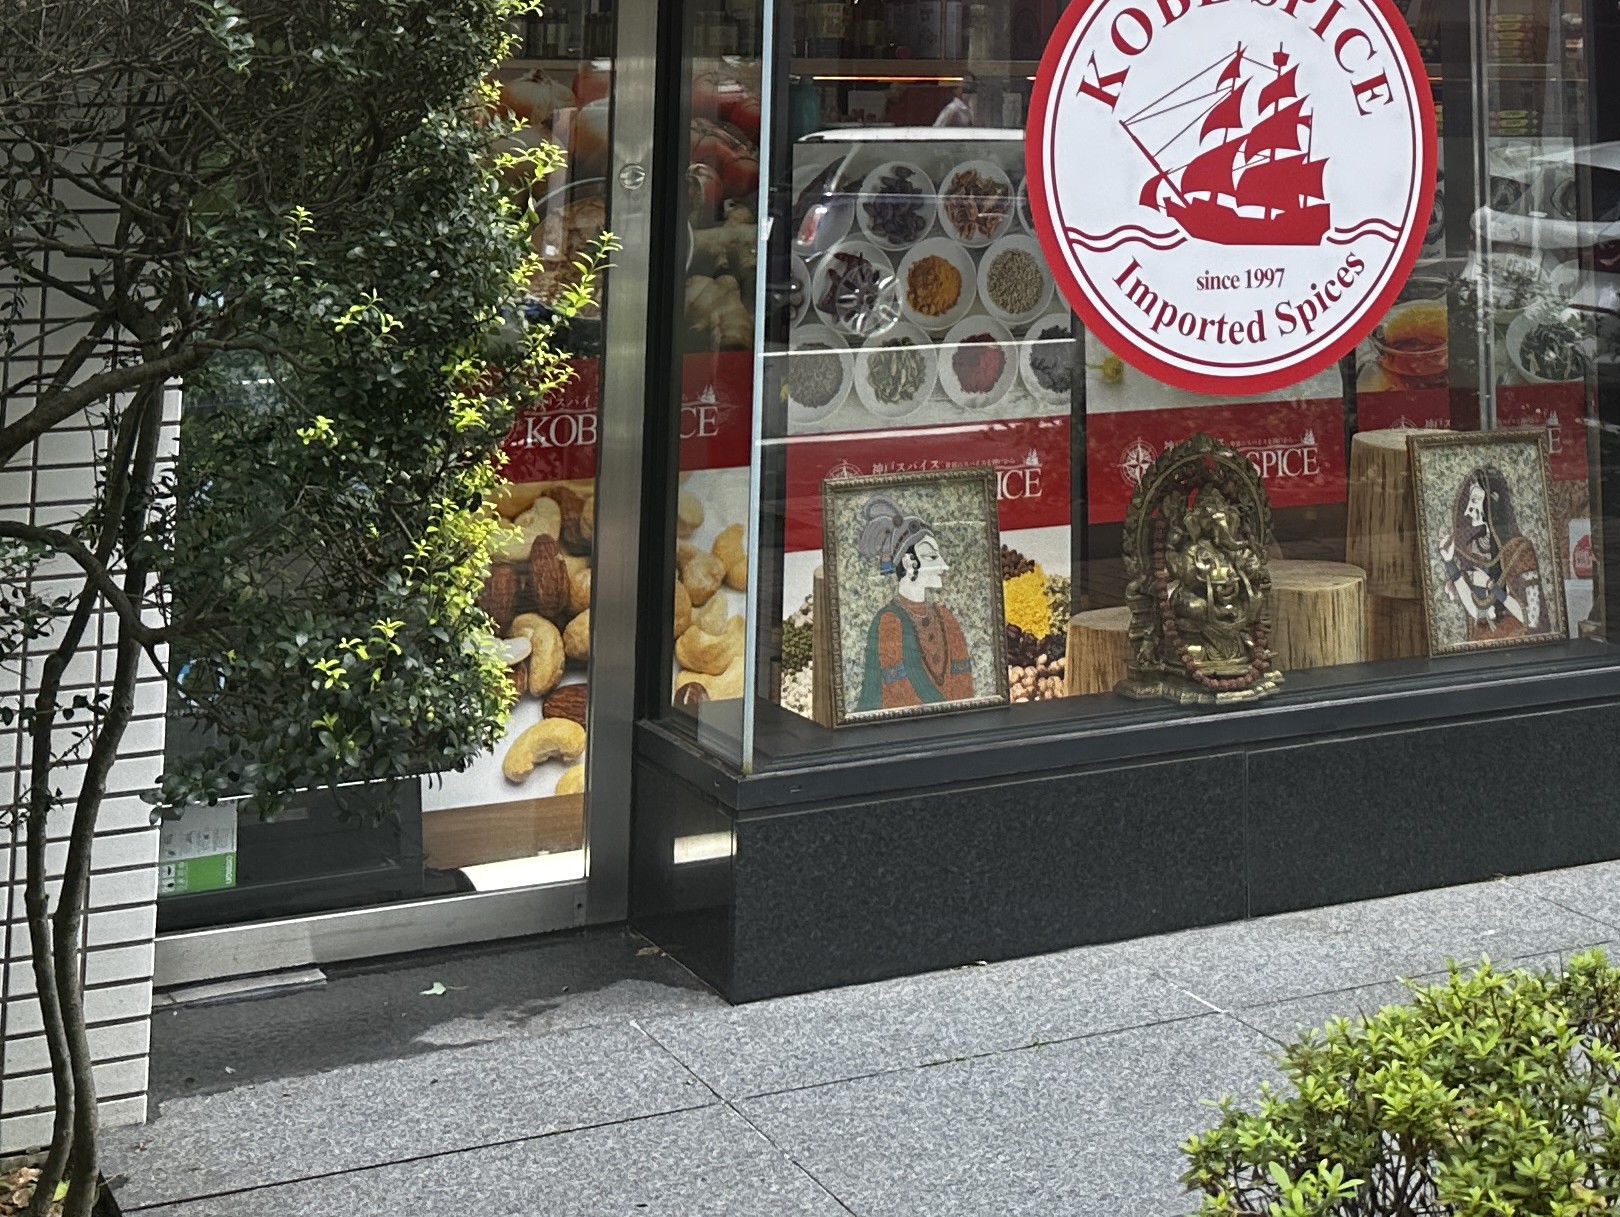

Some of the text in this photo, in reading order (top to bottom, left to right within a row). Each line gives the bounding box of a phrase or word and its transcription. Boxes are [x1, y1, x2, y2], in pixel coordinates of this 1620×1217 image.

[1196, 268, 1285, 291] since 1997
[1111, 252, 1365, 345] Imported Spices
[524, 413, 597, 449] KOB
[996, 467, 1044, 501] ICE
